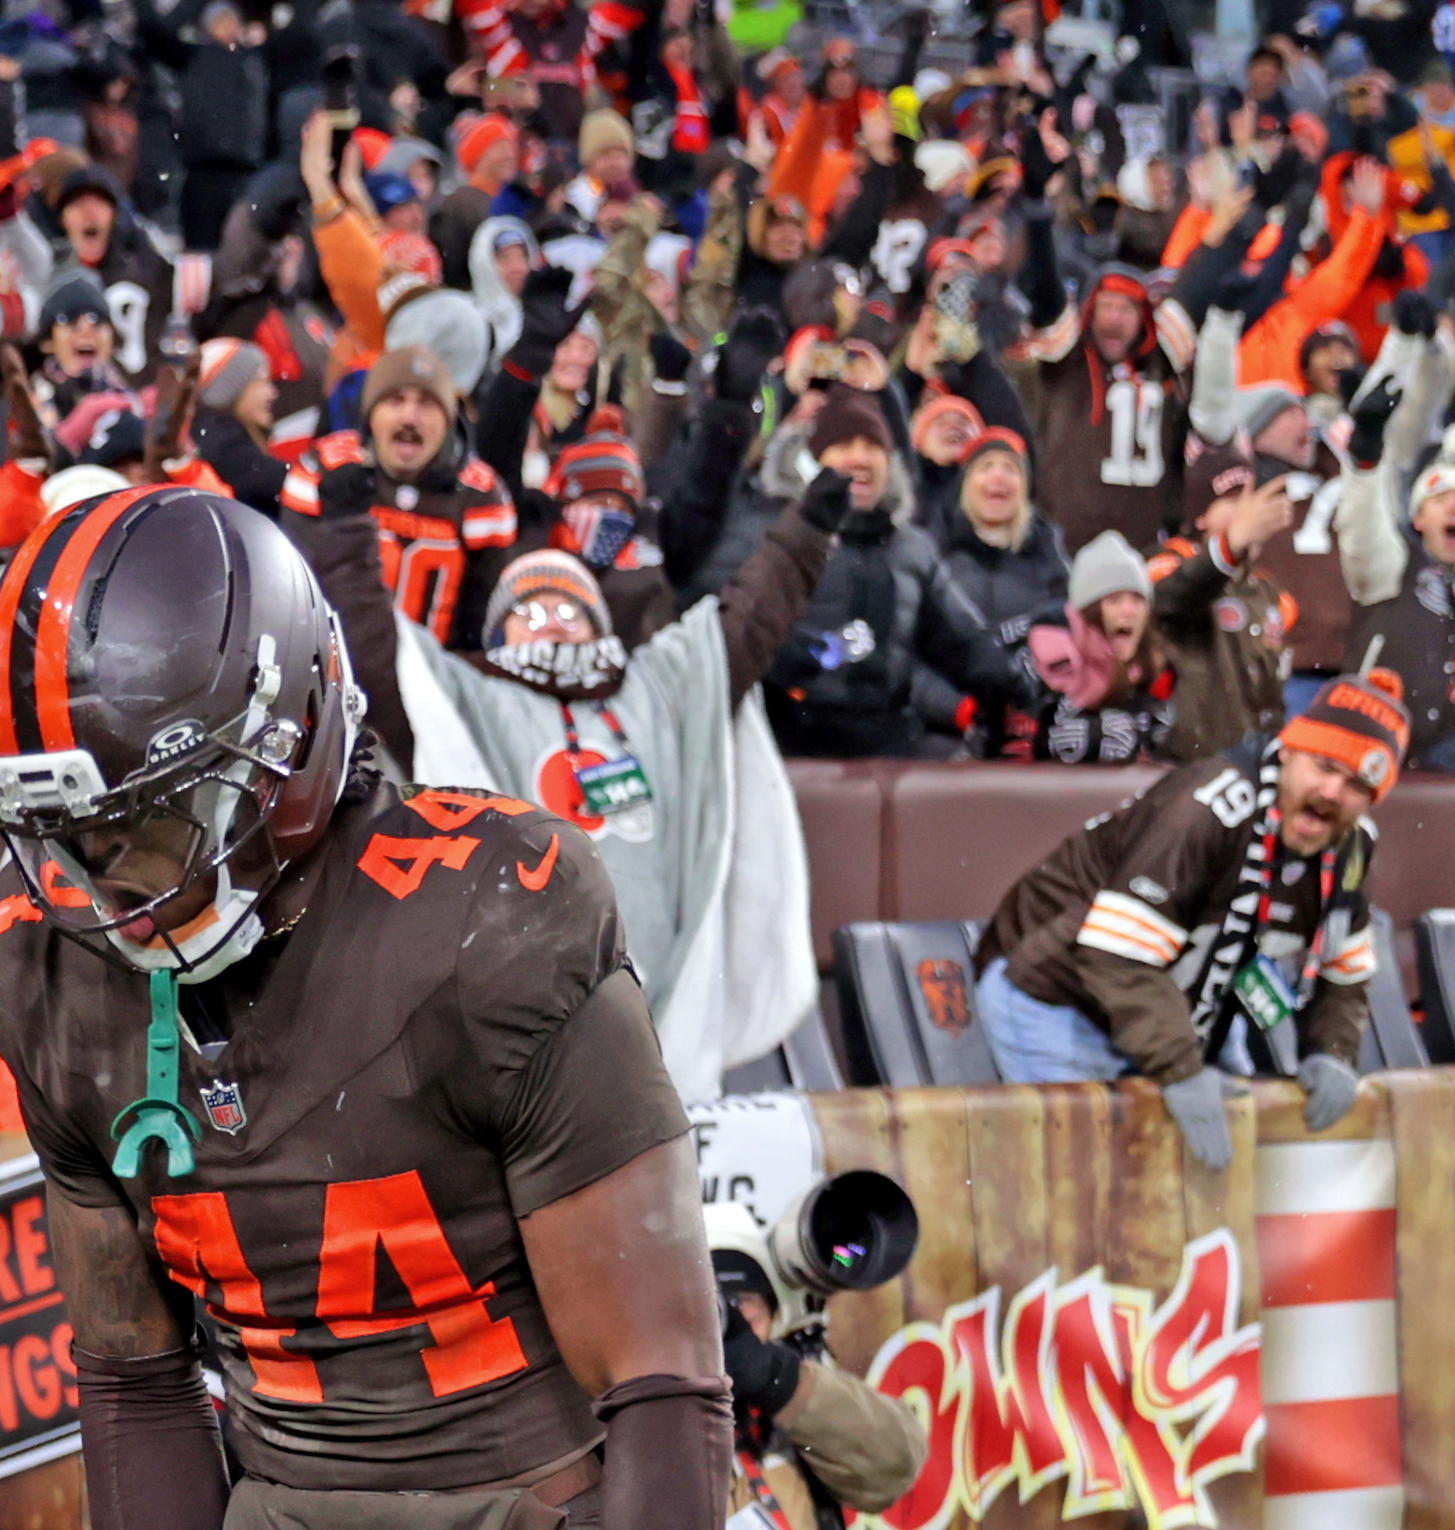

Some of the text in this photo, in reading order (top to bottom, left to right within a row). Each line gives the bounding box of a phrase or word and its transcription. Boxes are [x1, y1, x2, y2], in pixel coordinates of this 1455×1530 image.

[149, 733, 205, 764] OAKLEY
[1193, 767, 1258, 829] 19
[355, 789, 537, 900] 44
